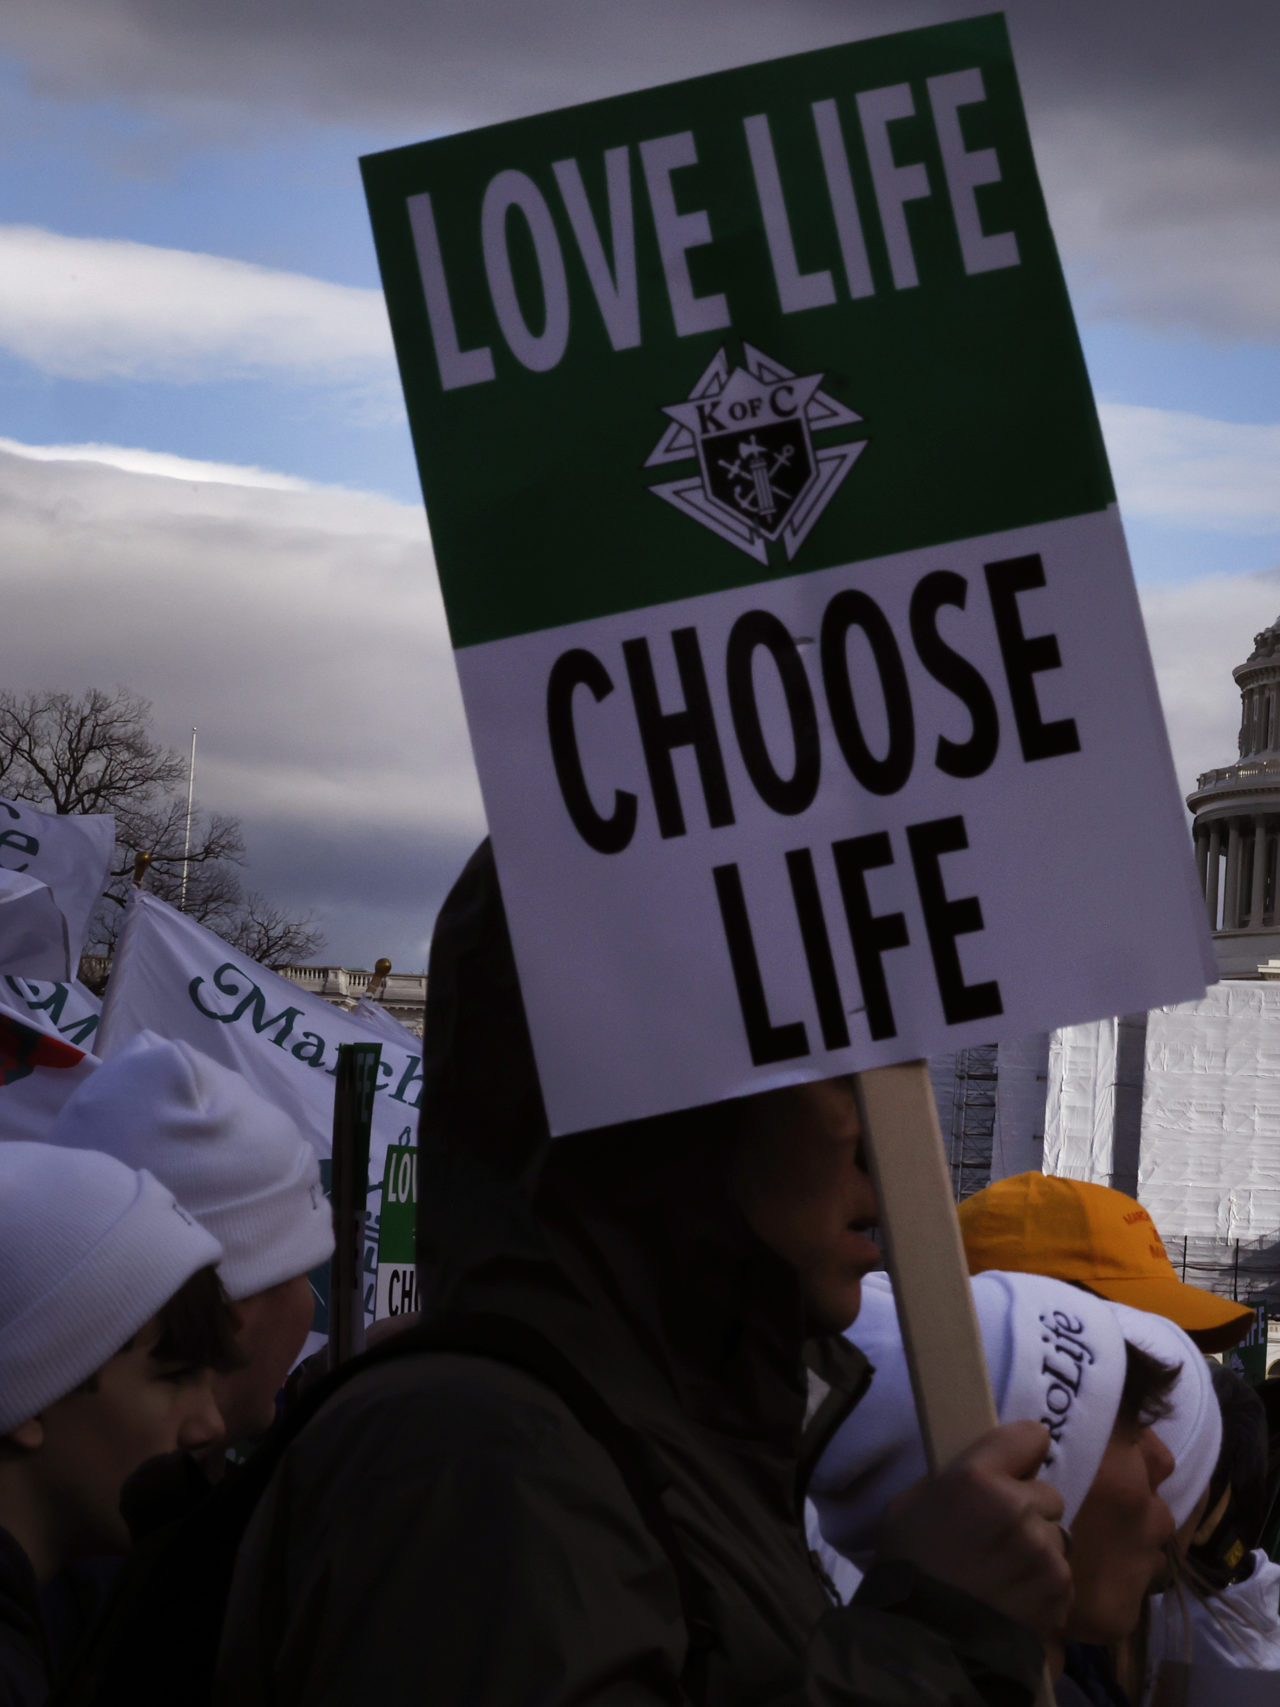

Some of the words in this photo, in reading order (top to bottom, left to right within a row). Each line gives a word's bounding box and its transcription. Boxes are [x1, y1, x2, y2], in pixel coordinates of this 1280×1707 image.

[405, 130, 731, 393] LOVE
[743, 67, 1021, 315] LIFE
[695, 401, 728, 434] K
[728, 398, 762, 421] OF
[769, 385, 799, 418] C
[546, 554, 1080, 855] CHOOSE
[712, 816, 1003, 1066] LIFE
